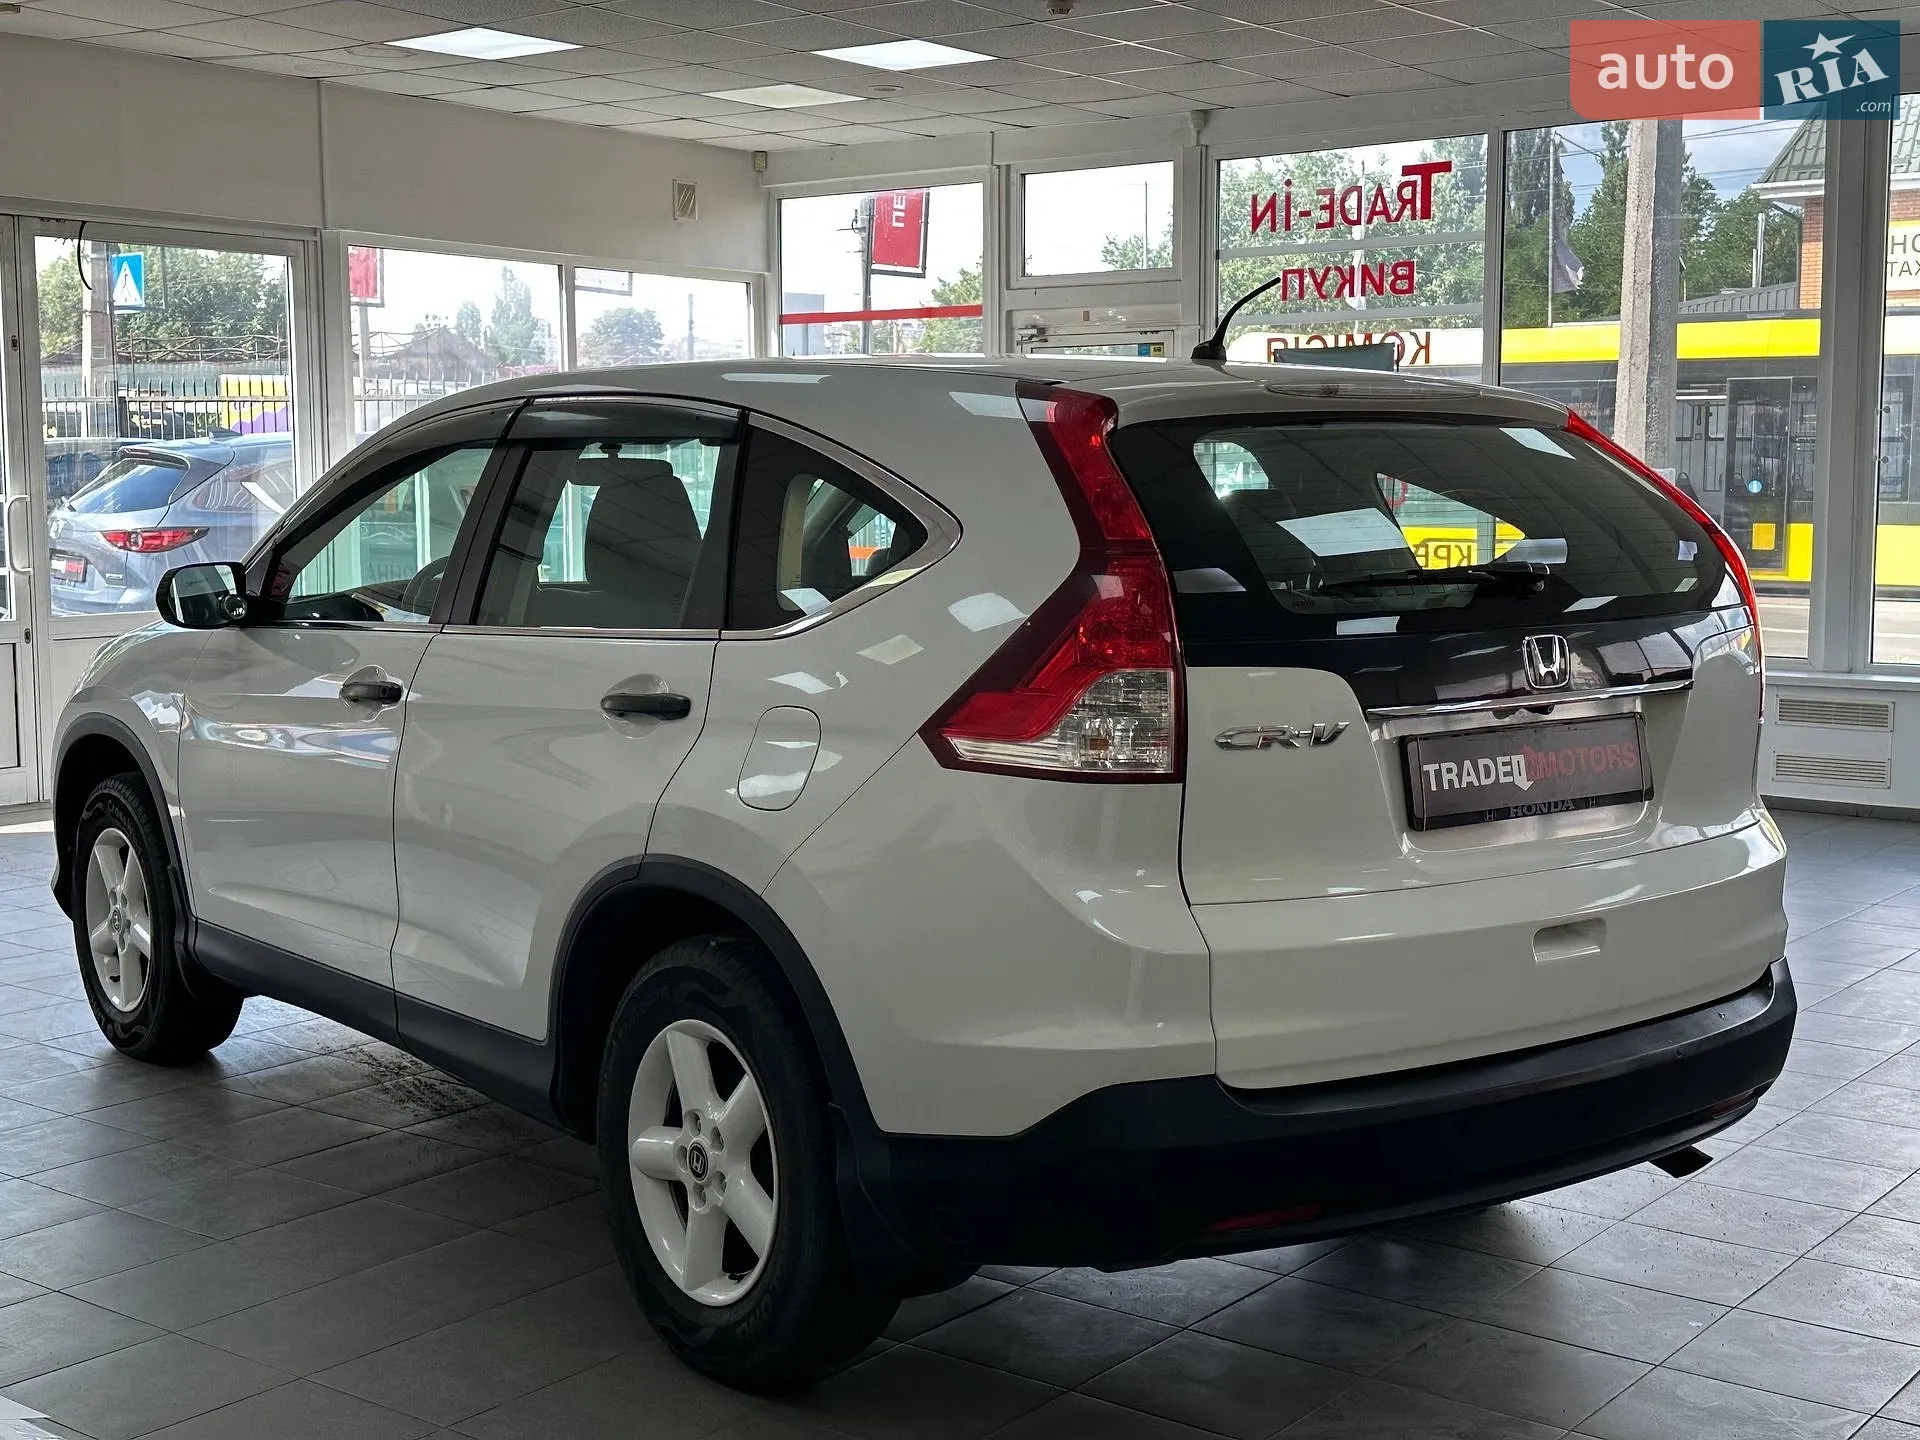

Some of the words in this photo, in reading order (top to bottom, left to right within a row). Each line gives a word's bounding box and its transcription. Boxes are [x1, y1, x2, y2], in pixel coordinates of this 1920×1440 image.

[1214, 721, 1350, 750] CR-V
[1537, 742, 1638, 778] MOTORS
[1508, 798, 1576, 818] HONDA
